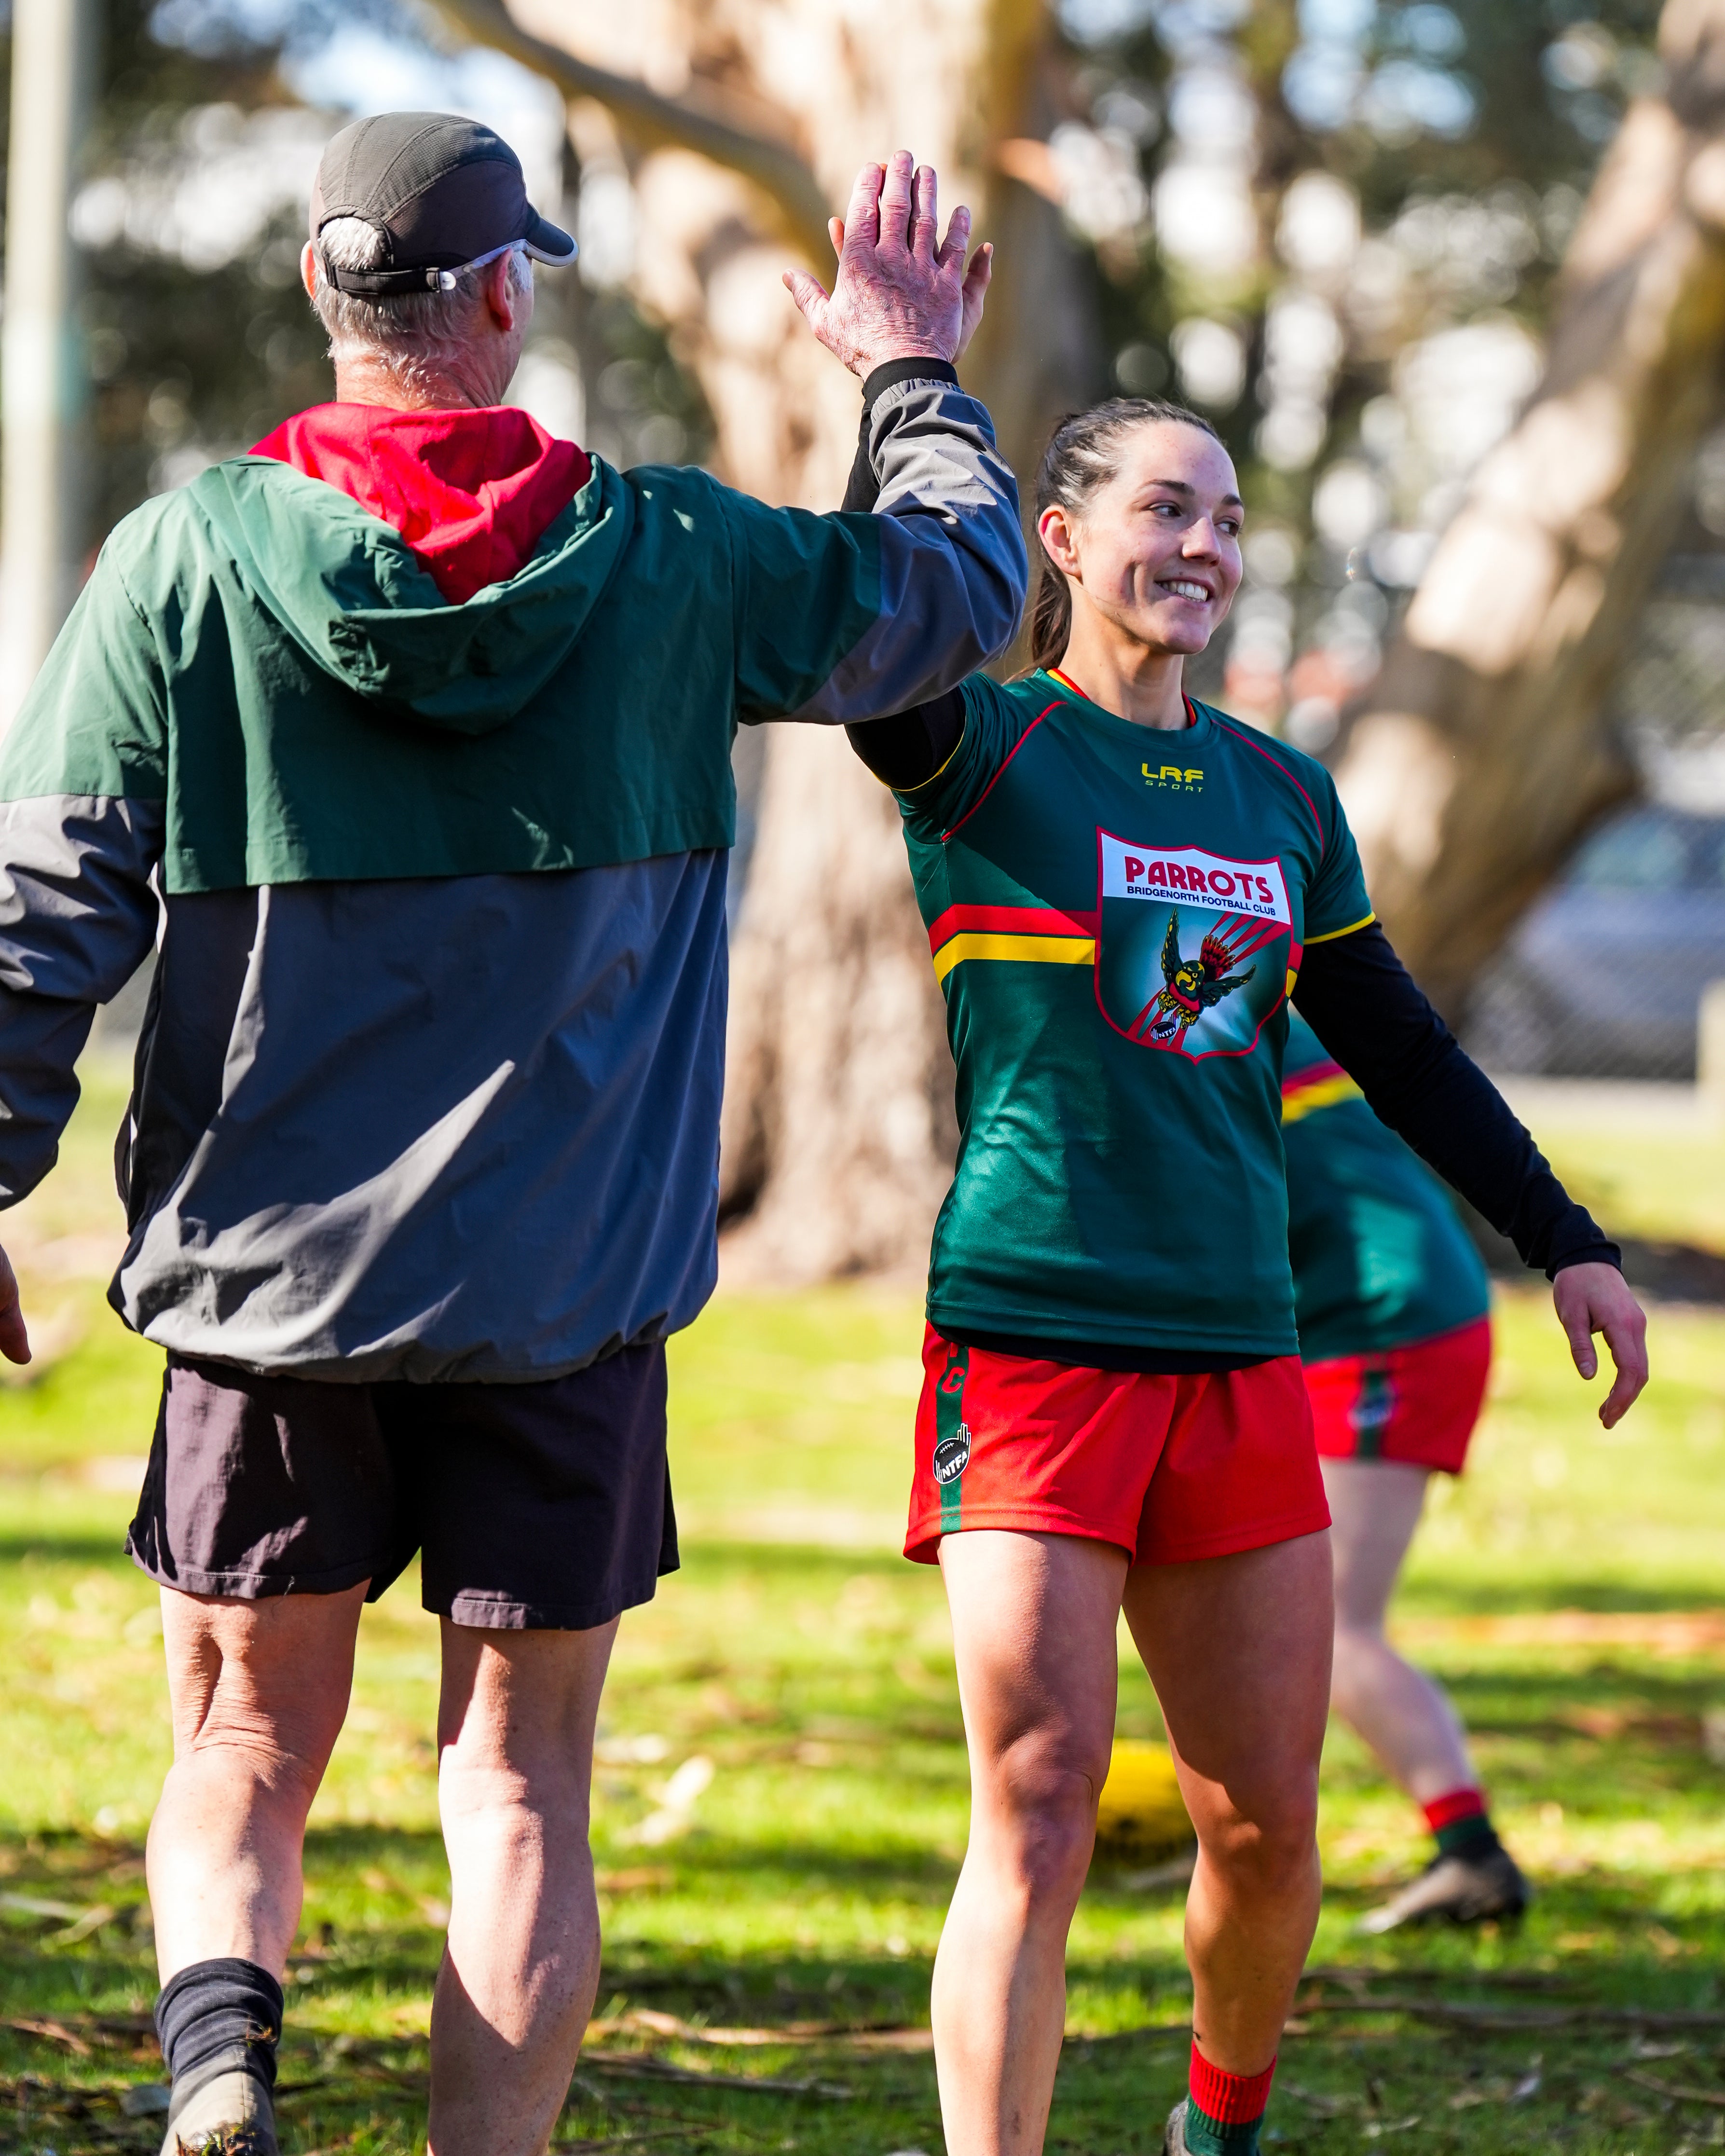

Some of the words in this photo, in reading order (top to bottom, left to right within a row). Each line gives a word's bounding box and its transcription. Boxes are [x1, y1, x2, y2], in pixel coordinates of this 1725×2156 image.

[1141, 763, 1204, 783] LRF
[1145, 780, 1204, 793] SPORT
[1124, 855, 1274, 904] PARROTS
[1127, 886, 1200, 903] BRIDGENORTH
[1202, 895, 1252, 911] FOOTBALL
[1253, 904, 1276, 916] CLUB
[1158, 1027, 1176, 1038] NTFA
[942, 1451, 968, 1479] NTFA
